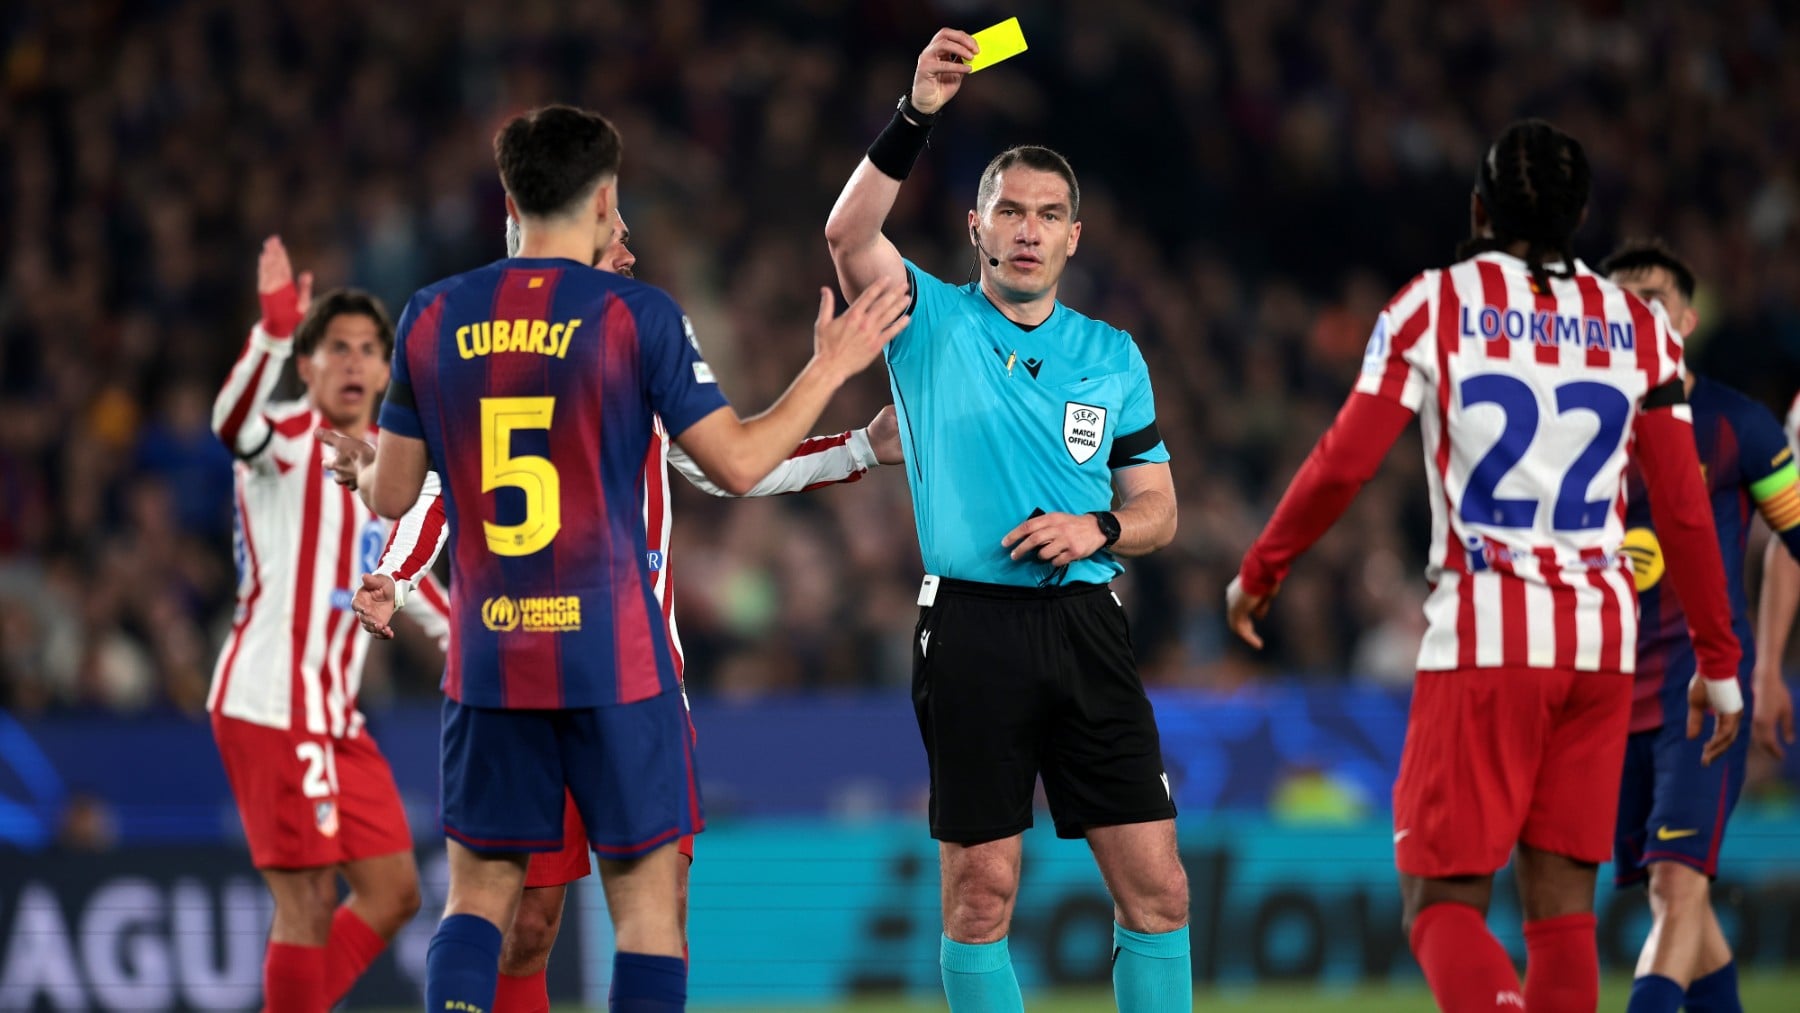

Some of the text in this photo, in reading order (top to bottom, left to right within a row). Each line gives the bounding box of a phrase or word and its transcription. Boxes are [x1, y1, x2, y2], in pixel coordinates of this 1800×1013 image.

[456, 319, 582, 359] CUBARSÍ
[1461, 305, 1635, 352] LOOKMAN
[1073, 411, 1097, 424] UEFA
[1068, 436, 1096, 448] OFFICIAL
[1072, 428, 1095, 438] MATCH
[1459, 373, 1631, 531] 22
[480, 396, 561, 556] 5
[520, 596, 580, 612] UNHCR
[522, 611, 580, 627] ACNUR
[0, 876, 272, 1011] AGU
